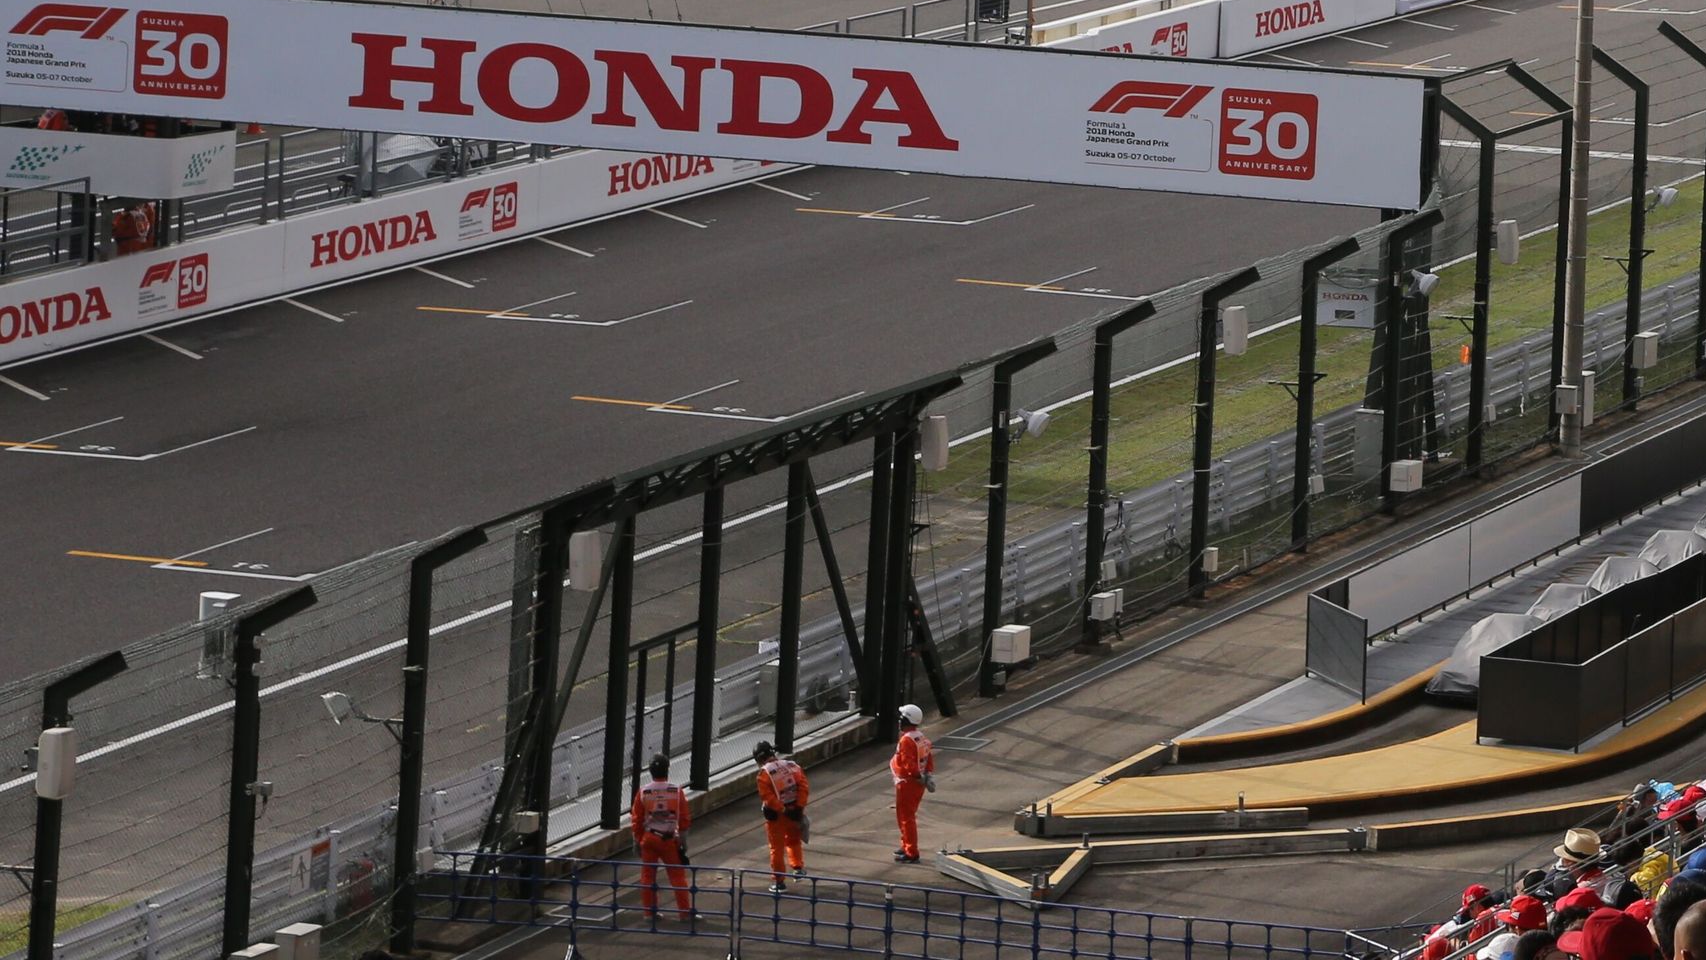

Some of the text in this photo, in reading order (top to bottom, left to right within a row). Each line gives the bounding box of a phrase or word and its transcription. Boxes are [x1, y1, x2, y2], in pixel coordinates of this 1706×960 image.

[142, 17, 184, 27] SUZUKA
[1255, 0, 1325, 38] HONDA
[1173, 27, 1188, 52] 30
[7, 42, 38, 51] Formula
[6, 49, 54, 59] 2018 Honda
[140, 29, 221, 80] 30
[6, 56, 87, 69] Japanese Grand Prix
[6, 70, 34, 80] Suzuka
[61, 75, 93, 84] October
[140, 80, 219, 92] ANNIVERSARY
[348, 32, 959, 151] HONDA
[1228, 95, 1272, 105] SUZUKA
[1086, 120, 1120, 129] Formula
[1086, 127, 1135, 138] 2018 Honda
[1226, 108, 1310, 160] 30
[1085, 135, 1169, 147] Japanese Grand Prix
[1085, 149, 1176, 163] Suzuka 05-07 October
[1226, 160, 1308, 173] ANNIVERSARY
[607, 153, 714, 197] HONDA
[494, 192, 516, 221] 30
[310, 210, 437, 268] HONDA
[180, 264, 207, 296] 30
[1322, 292, 1369, 302] HONDA
